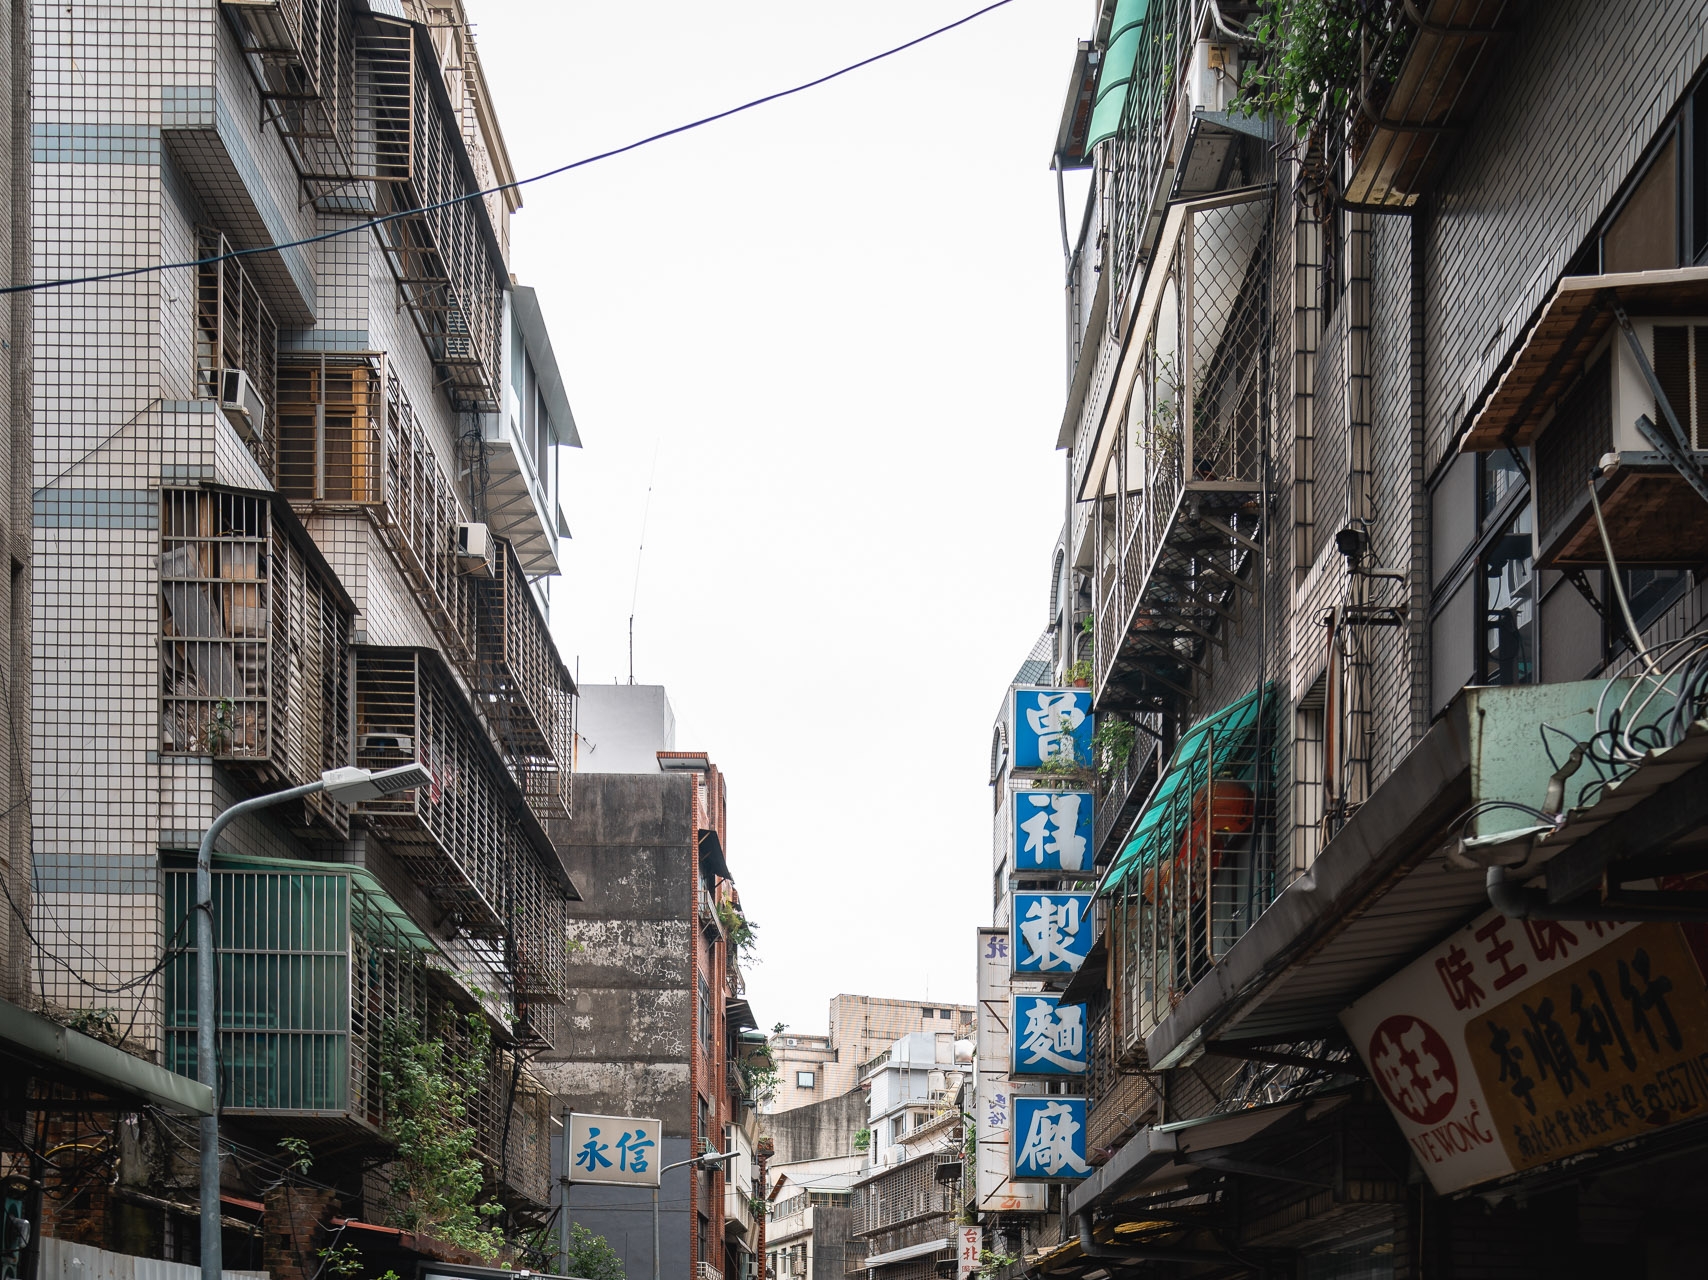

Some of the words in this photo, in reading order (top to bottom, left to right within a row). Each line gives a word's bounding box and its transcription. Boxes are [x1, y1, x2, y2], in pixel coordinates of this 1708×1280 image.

[1434, 915, 1633, 1011] 味王味
[1486, 948, 1683, 1116] 李順利行
[575, 1127, 655, 1174] 永信
[963, 1228, 978, 1261] 台北
